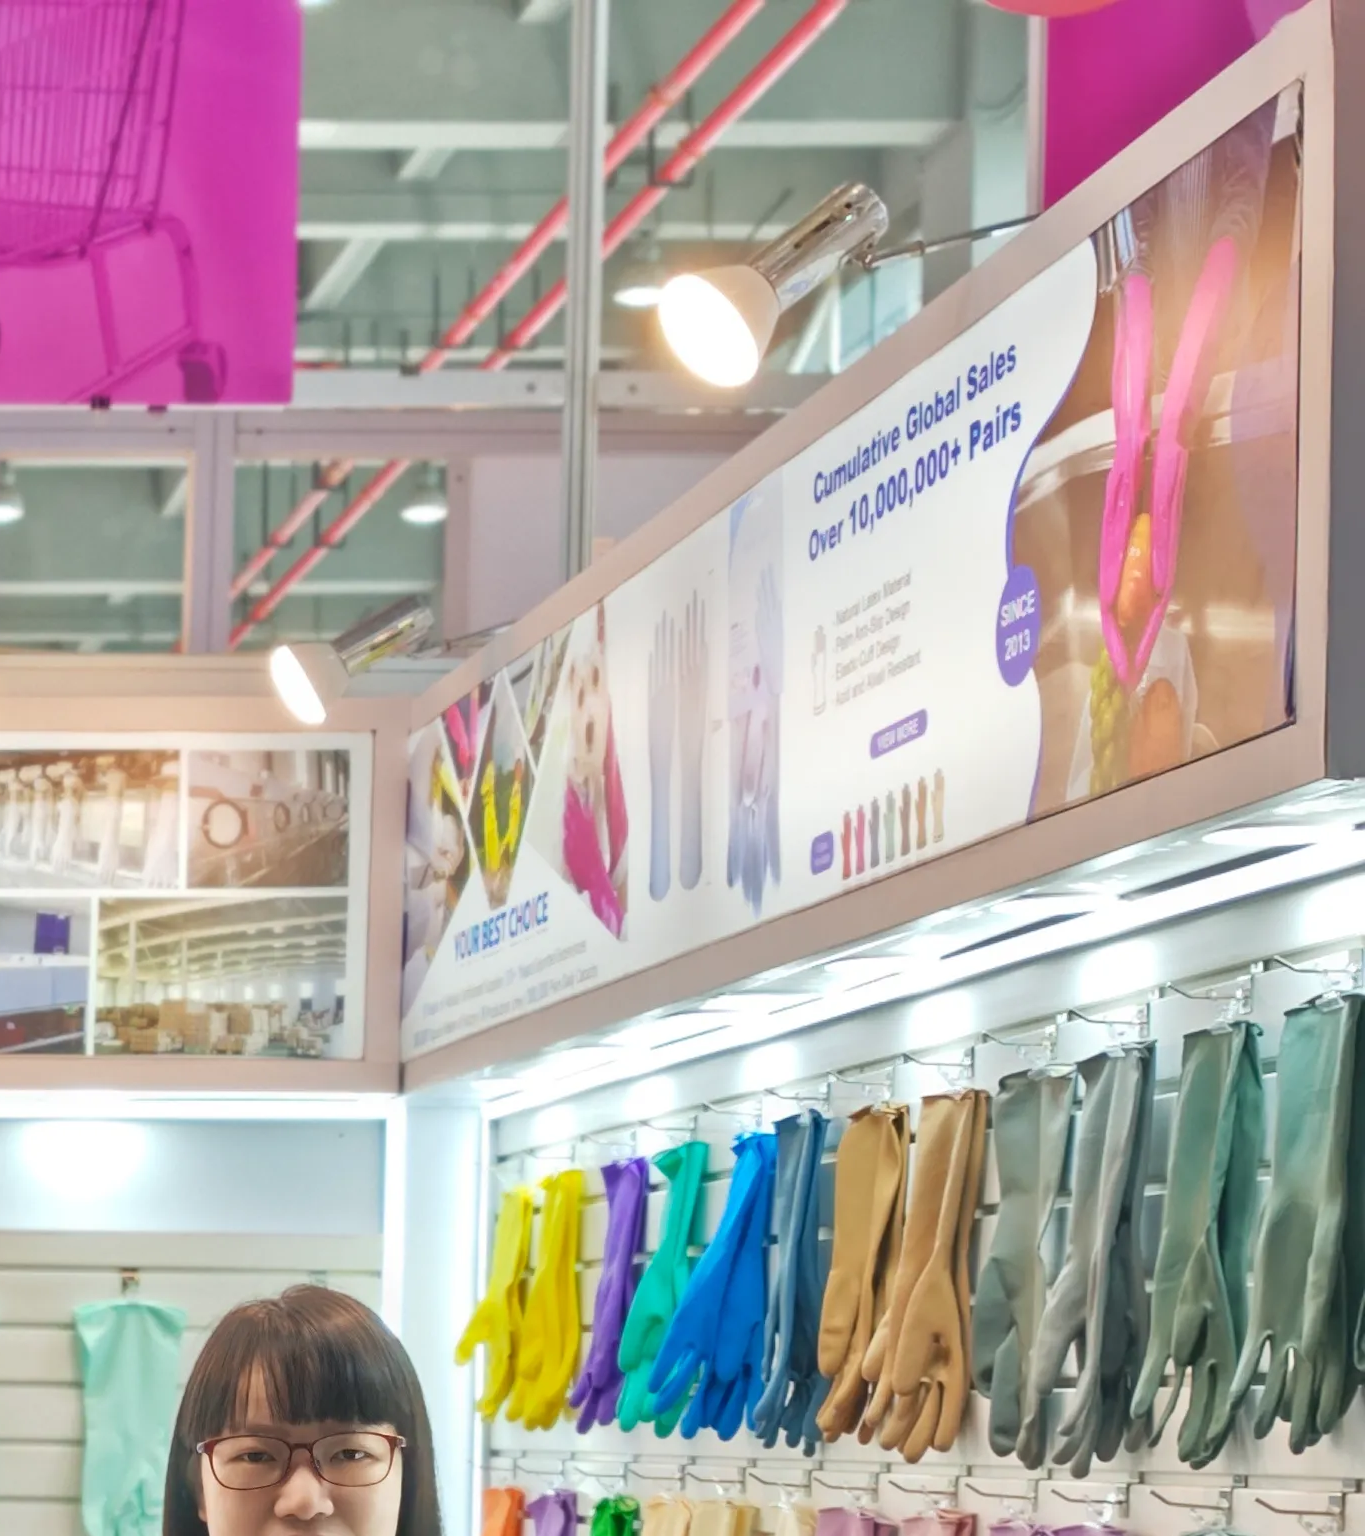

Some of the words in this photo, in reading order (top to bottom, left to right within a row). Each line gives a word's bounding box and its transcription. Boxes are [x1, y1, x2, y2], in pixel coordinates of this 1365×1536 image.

[811, 424, 903, 506] Cumulative
[906, 383, 962, 440] Global
[967, 344, 1017, 403] Sales
[808, 510, 844, 562] Over
[847, 439, 962, 537] 10,000,000+
[968, 401, 1022, 461] Pairs
[1000, 590, 1035, 627] SINCE
[1004, 629, 1031, 661] 2013
[454, 924, 480, 963] YOUR
[482, 910, 507, 950] BEST
[509, 892, 549, 939] CHOICE
